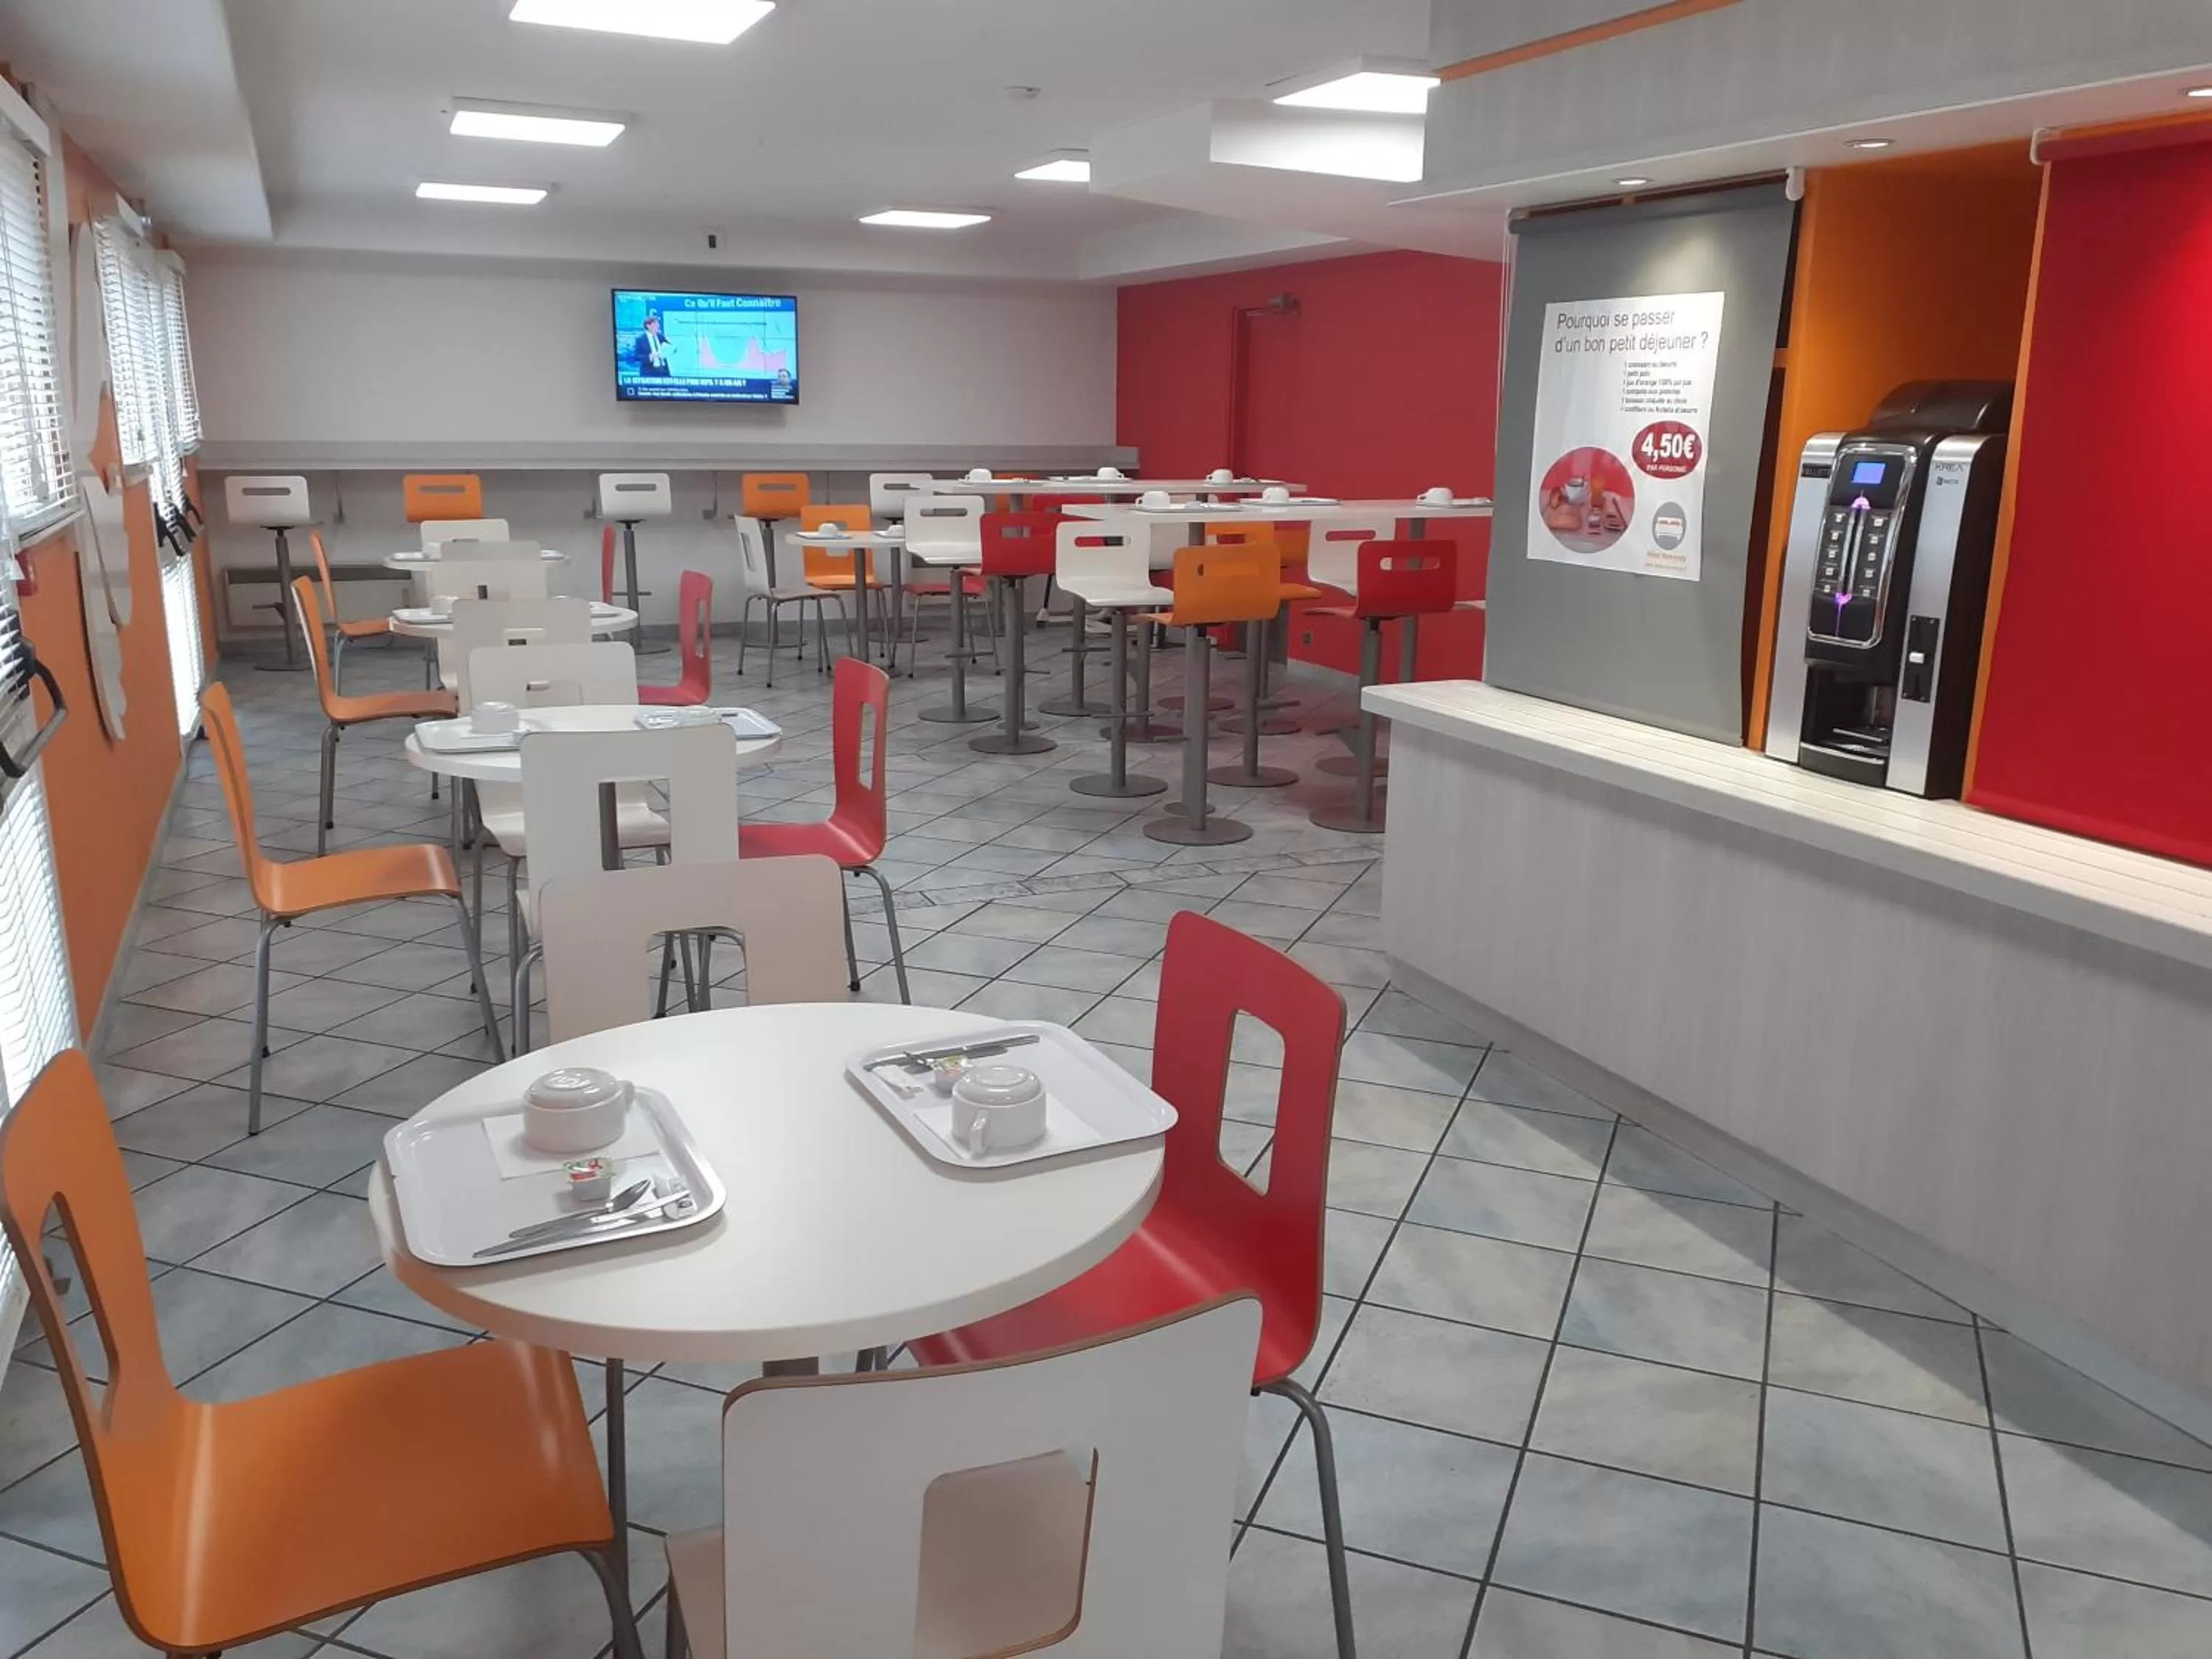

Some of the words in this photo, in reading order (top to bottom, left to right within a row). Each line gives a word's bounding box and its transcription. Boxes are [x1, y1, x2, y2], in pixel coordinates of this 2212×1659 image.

[1557, 313, 1610, 331] Pourquoi
[1613, 313, 1629, 327] se
[1632, 310, 1675, 331] passer
[1555, 335, 1581, 353] d'un
[1584, 334, 1605, 352] bon
[1609, 333, 1636, 354] petit
[1639, 333, 1696, 355] déjeuner
[1701, 330, 1708, 349] ?
[1641, 431, 1696, 462] 4,50€
